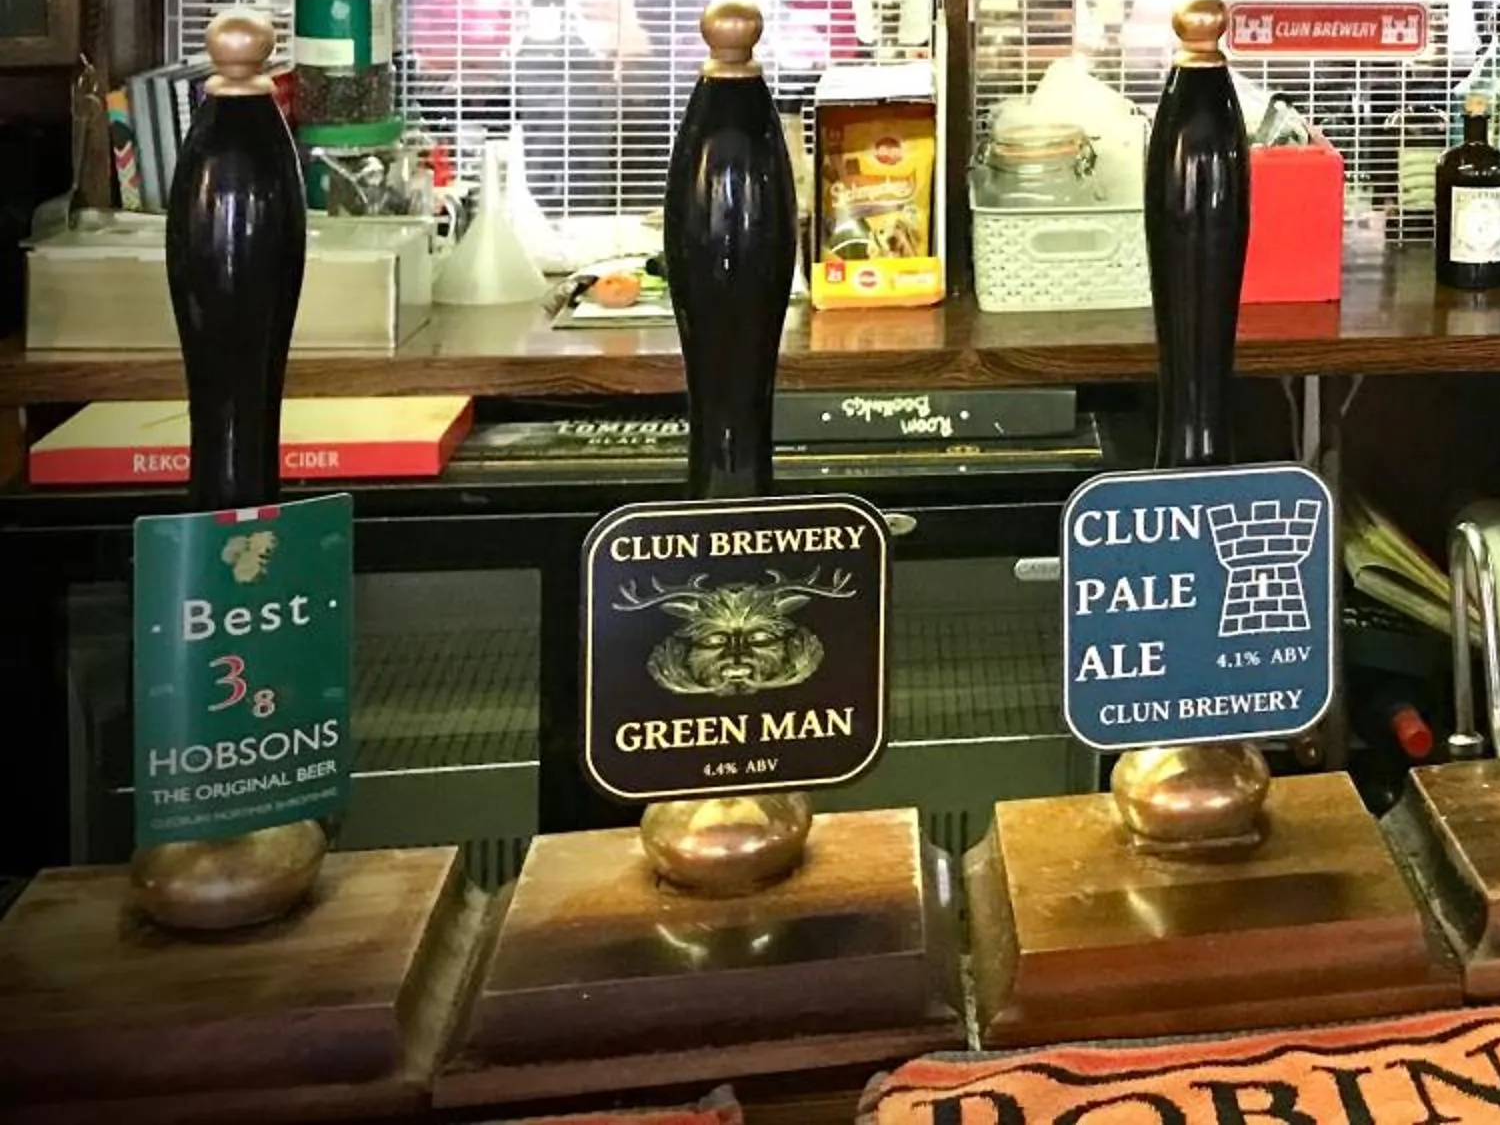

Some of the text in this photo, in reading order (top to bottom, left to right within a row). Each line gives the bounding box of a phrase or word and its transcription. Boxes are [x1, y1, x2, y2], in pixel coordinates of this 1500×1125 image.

[1275, 21, 1379, 39] CLUN BREWERY
[841, 394, 931, 418] Bookings
[588, 436, 658, 445] BLACK
[900, 414, 956, 438] Room
[285, 451, 340, 469] CIDER
[610, 525, 866, 562] CLUN BREWERY
[1073, 505, 1203, 547] CLUN
[1075, 573, 1198, 616] PALE
[181, 594, 310, 642] Best
[1074, 641, 1167, 682] ALE
[1216, 646, 1312, 669] 4.1% ABV
[1100, 689, 1303, 725] CLUN BREWERY
[150, 719, 340, 777] HOBSONS
[615, 707, 856, 753] GREEN MAN
[151, 759, 338, 806] THE ORIGINAL BEER
[745, 758, 779, 774] ABV
